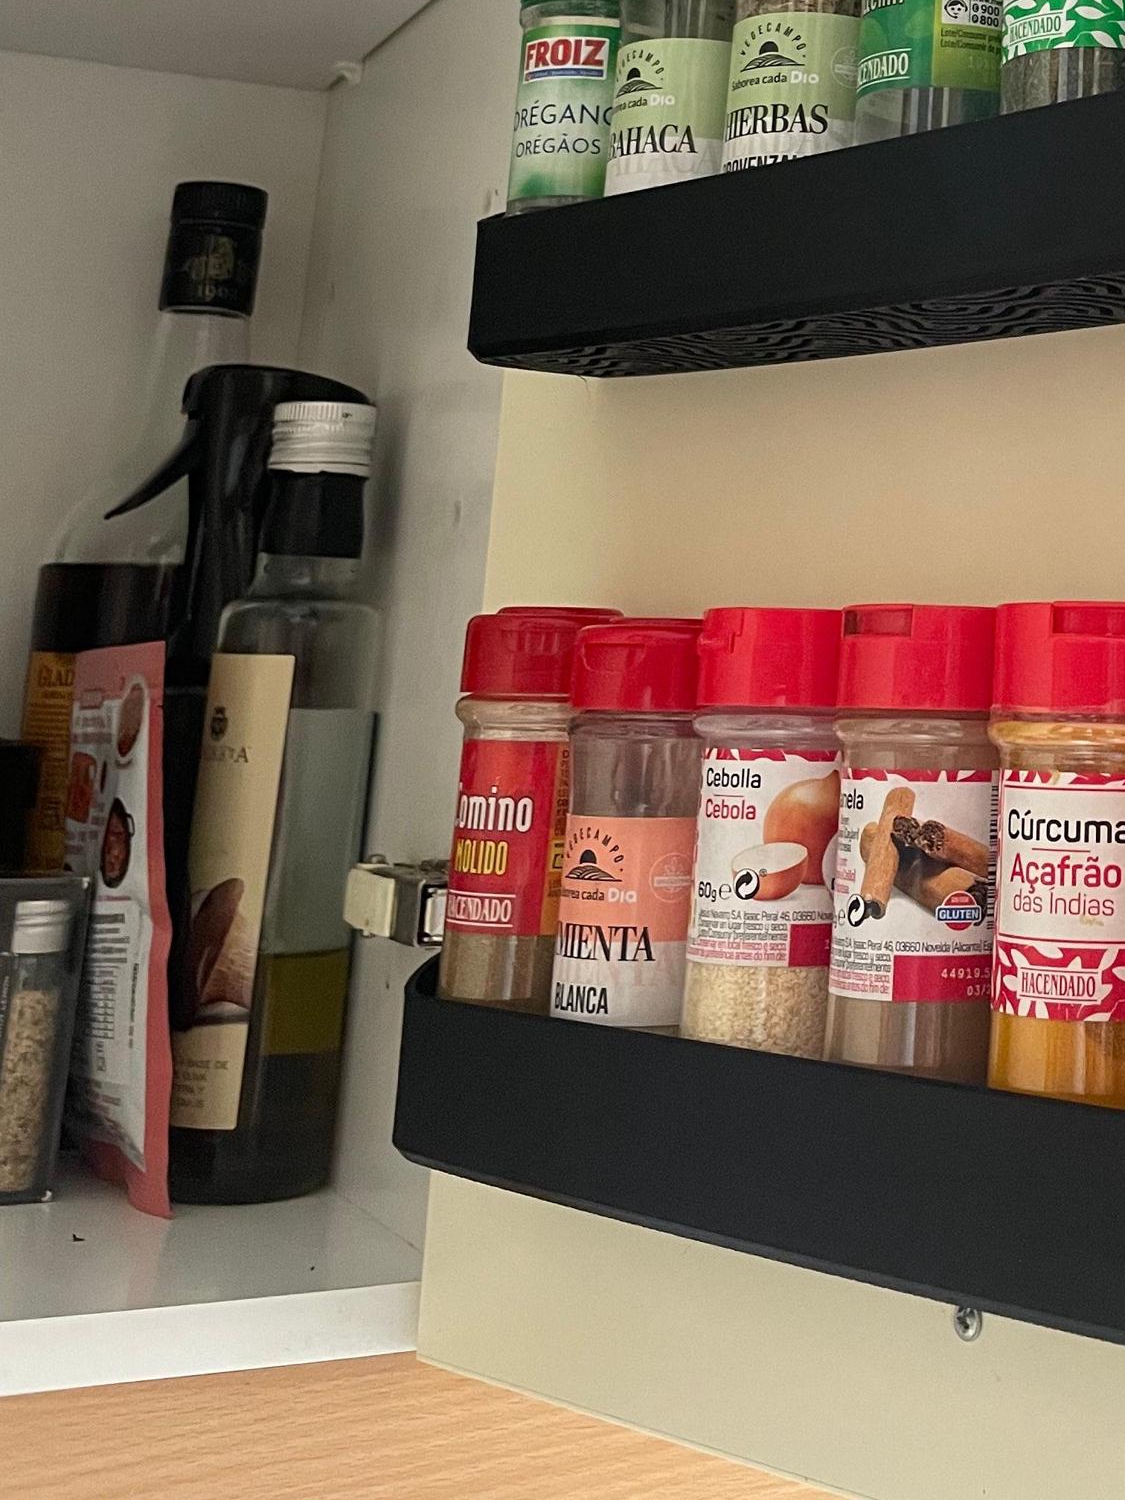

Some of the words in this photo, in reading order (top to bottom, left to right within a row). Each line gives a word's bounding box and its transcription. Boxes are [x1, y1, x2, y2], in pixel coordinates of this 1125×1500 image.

[980, 15, 999, 27] 800
[981, 5, 999, 16] 900
[1009, 15, 1062, 43] HACENDADO
[525, 39, 607, 70] FROIZ
[762, 72, 787, 84] cada
[628, 97, 648, 109] cada
[725, 103, 829, 142] HIERBAS
[516, 133, 601, 158] ORÉGÃOS
[706, 767, 762, 789] Cebolla
[456, 785, 534, 833] omino
[705, 798, 757, 820] Cebola
[455, 839, 508, 875] MOLIDO
[1010, 853, 1122, 893] Açafrão
[581, 886, 605, 901] cada
[698, 881, 717, 902] 60g
[1014, 889, 1042, 913] das
[1050, 887, 1115, 917] Índias
[939, 909, 979, 920] GLUTEN
[896, 941, 920, 952] 03660
[1021, 972, 1096, 998] HACENDADO
[555, 982, 609, 1015] BLANCA
